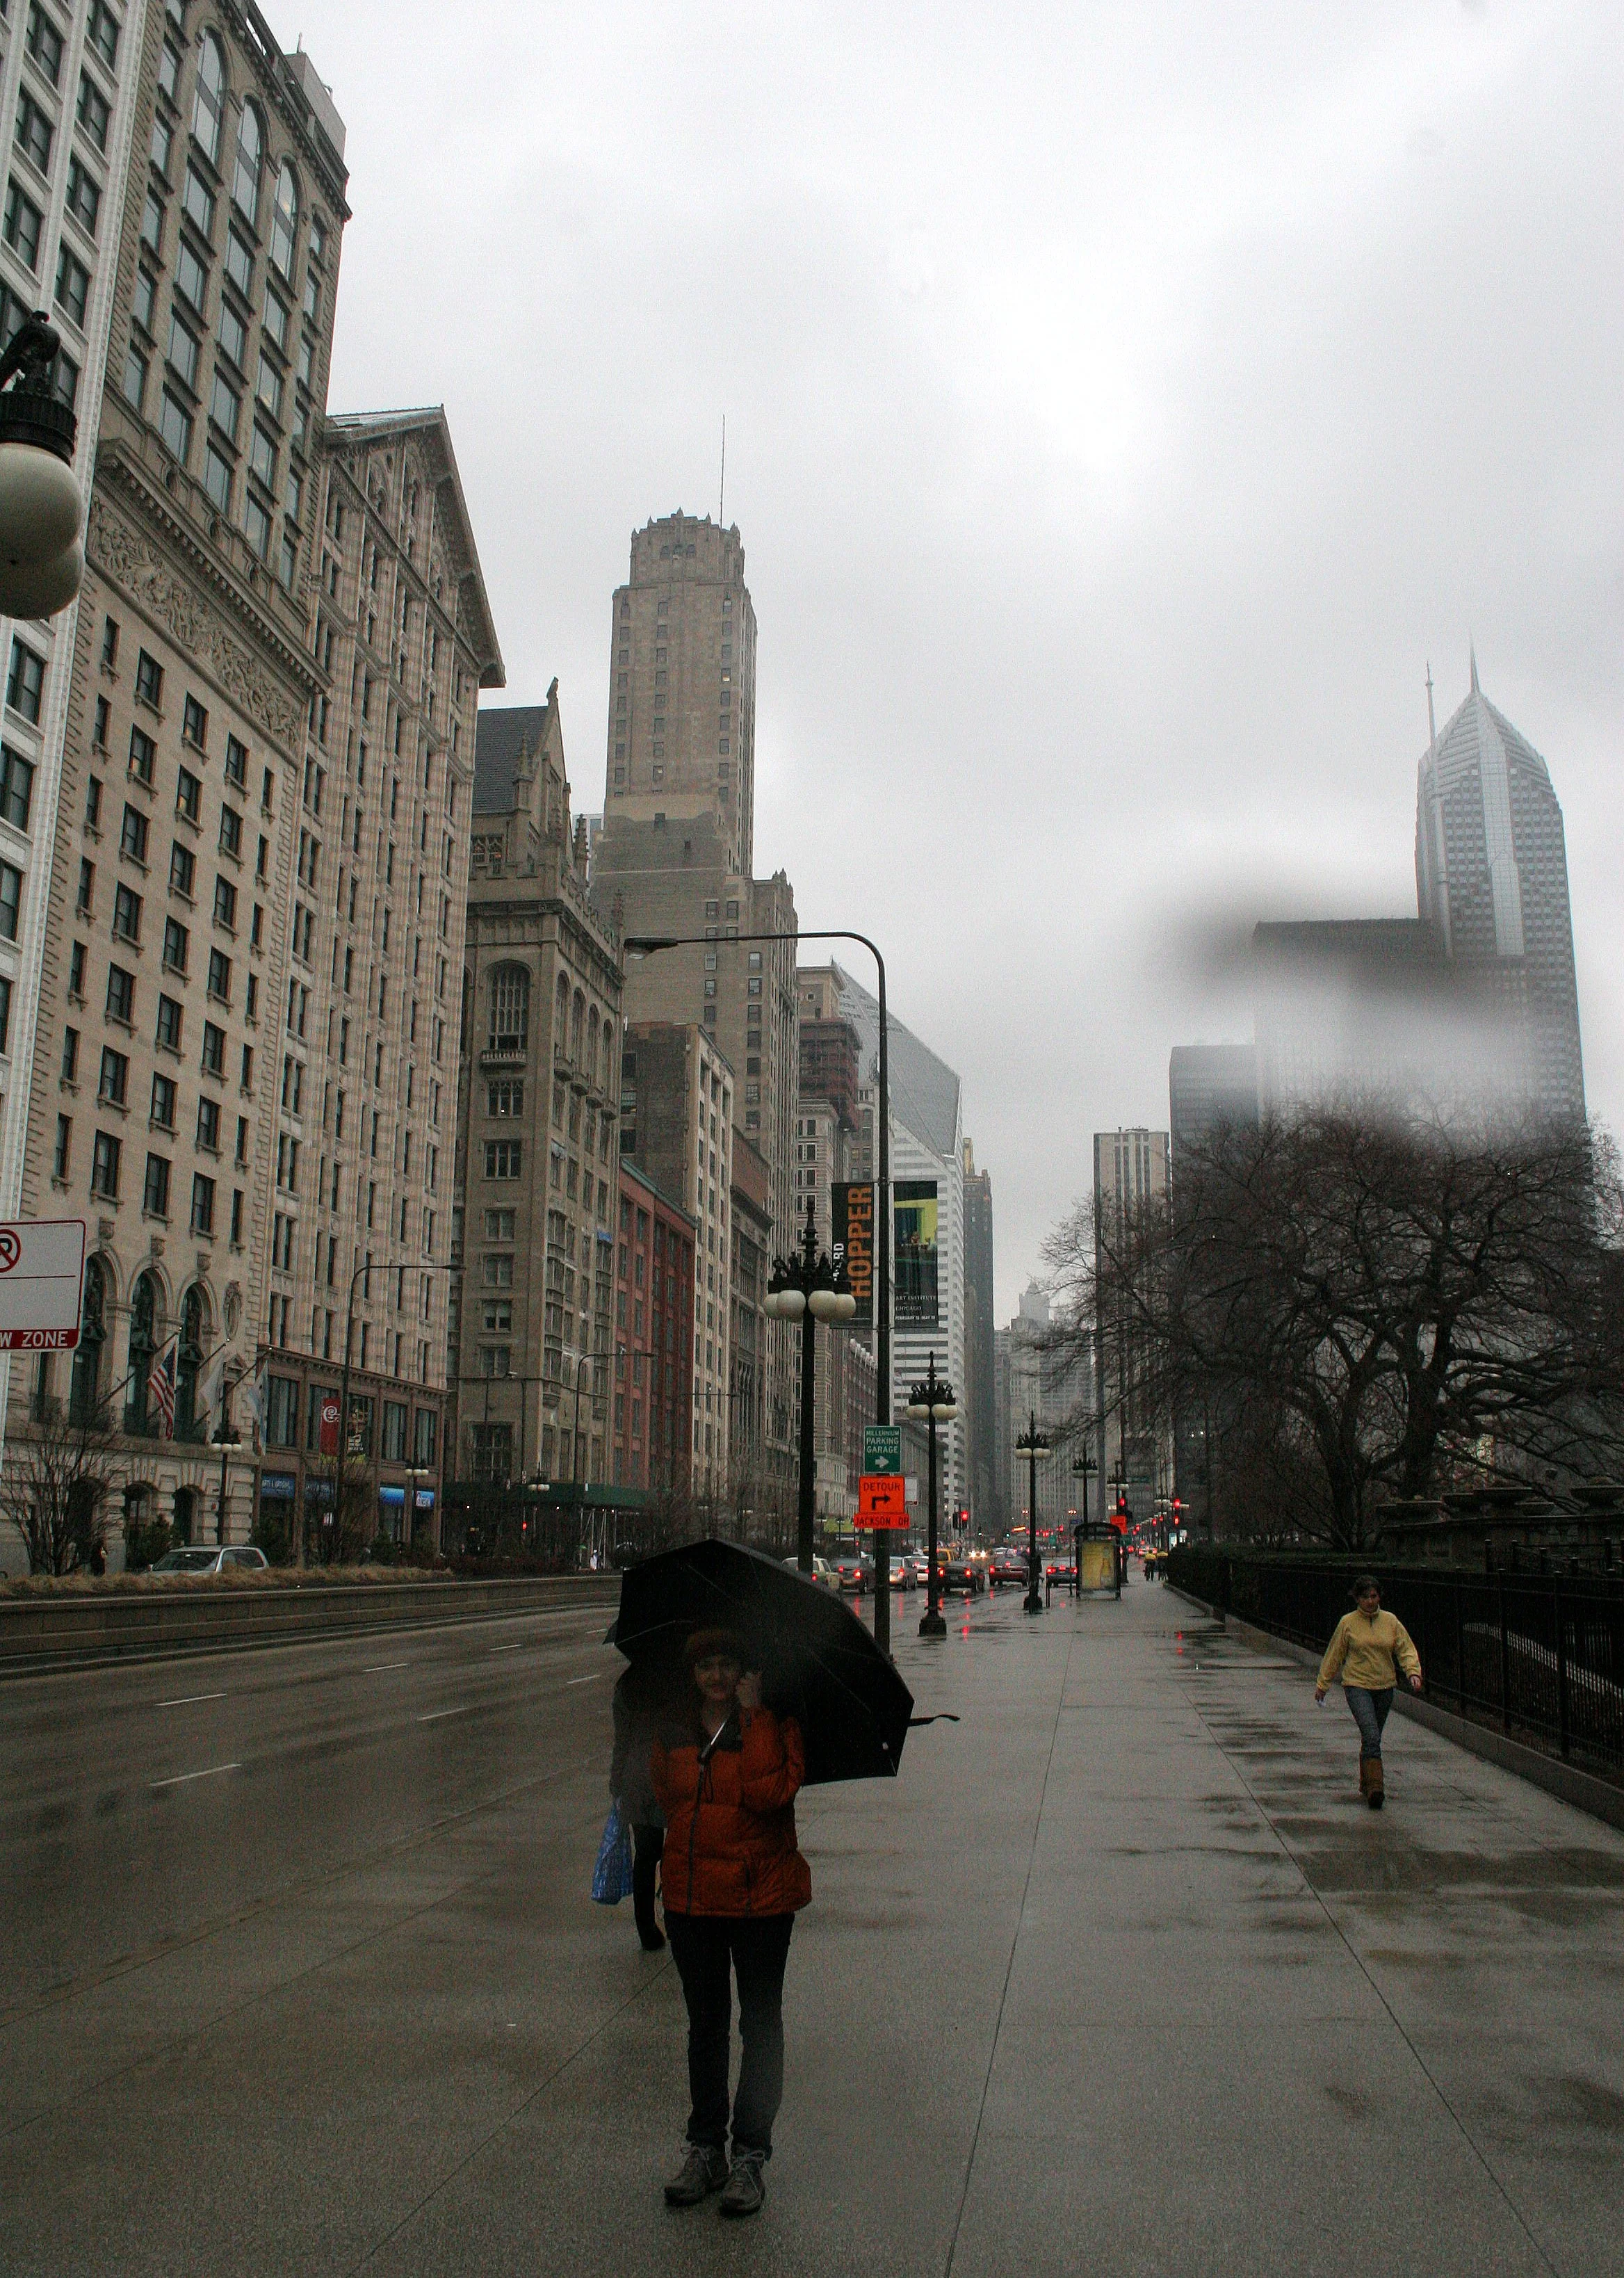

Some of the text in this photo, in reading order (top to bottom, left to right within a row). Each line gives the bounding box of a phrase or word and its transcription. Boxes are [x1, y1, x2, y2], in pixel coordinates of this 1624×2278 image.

[847, 1186, 872, 1297] HOPPER
[22, 1330, 68, 1348] ZONE
[866, 1437, 900, 1445] PARKING
[863, 1482, 901, 1492] DETOUR
[854, 1517, 891, 1526] JACKSON
